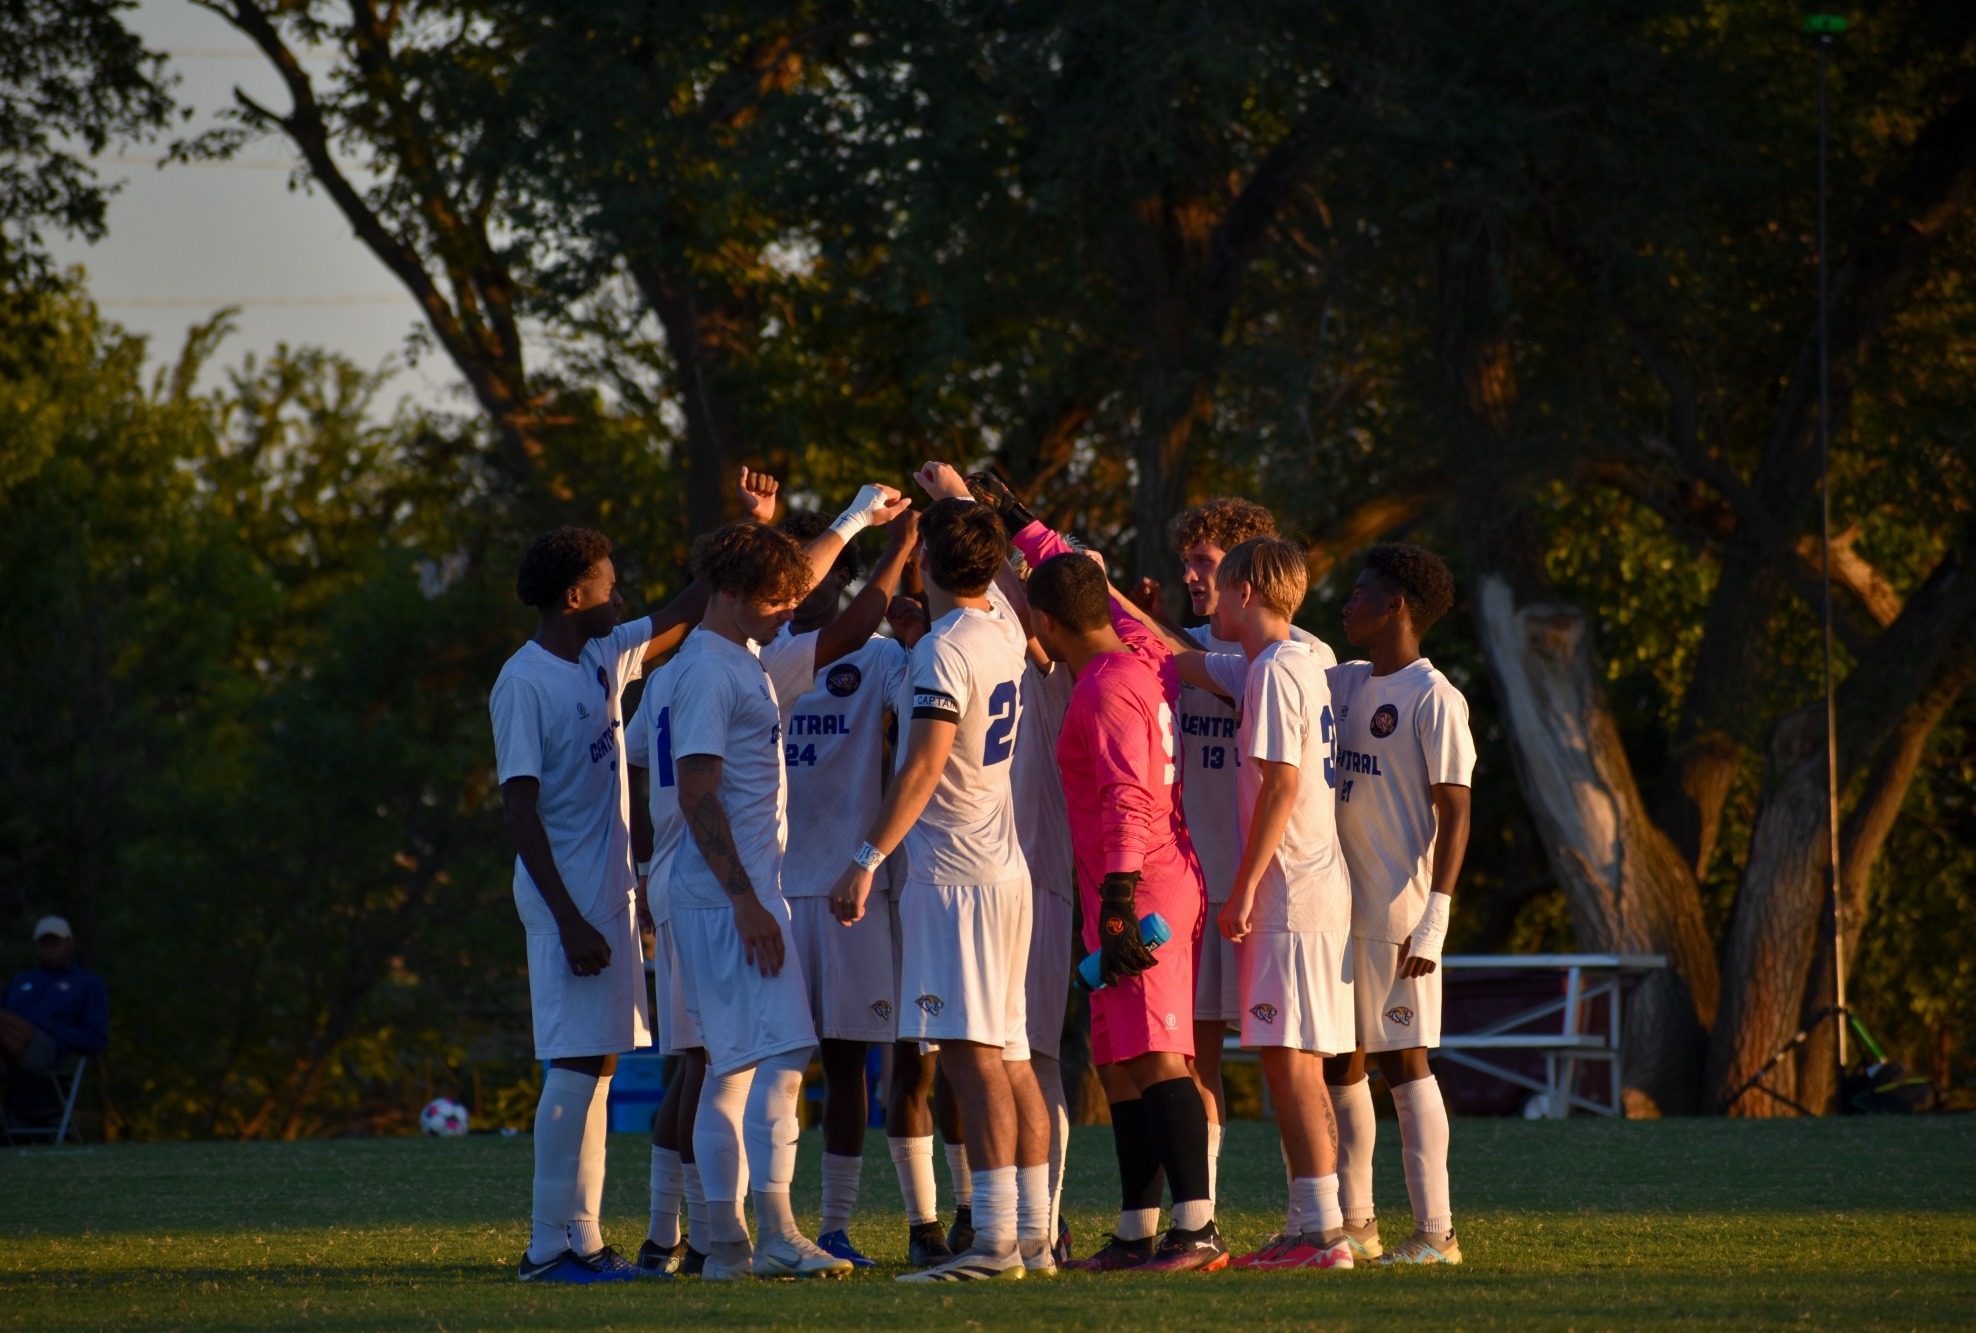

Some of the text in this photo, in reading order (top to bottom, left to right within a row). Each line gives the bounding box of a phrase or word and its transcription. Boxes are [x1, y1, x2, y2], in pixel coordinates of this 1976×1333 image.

[789, 715, 849, 735] TRAL
[982, 680, 1023, 767] 2
[1181, 713, 1235, 738] CENTR
[785, 744, 817, 766] 24
[1202, 746, 1225, 769] 13
